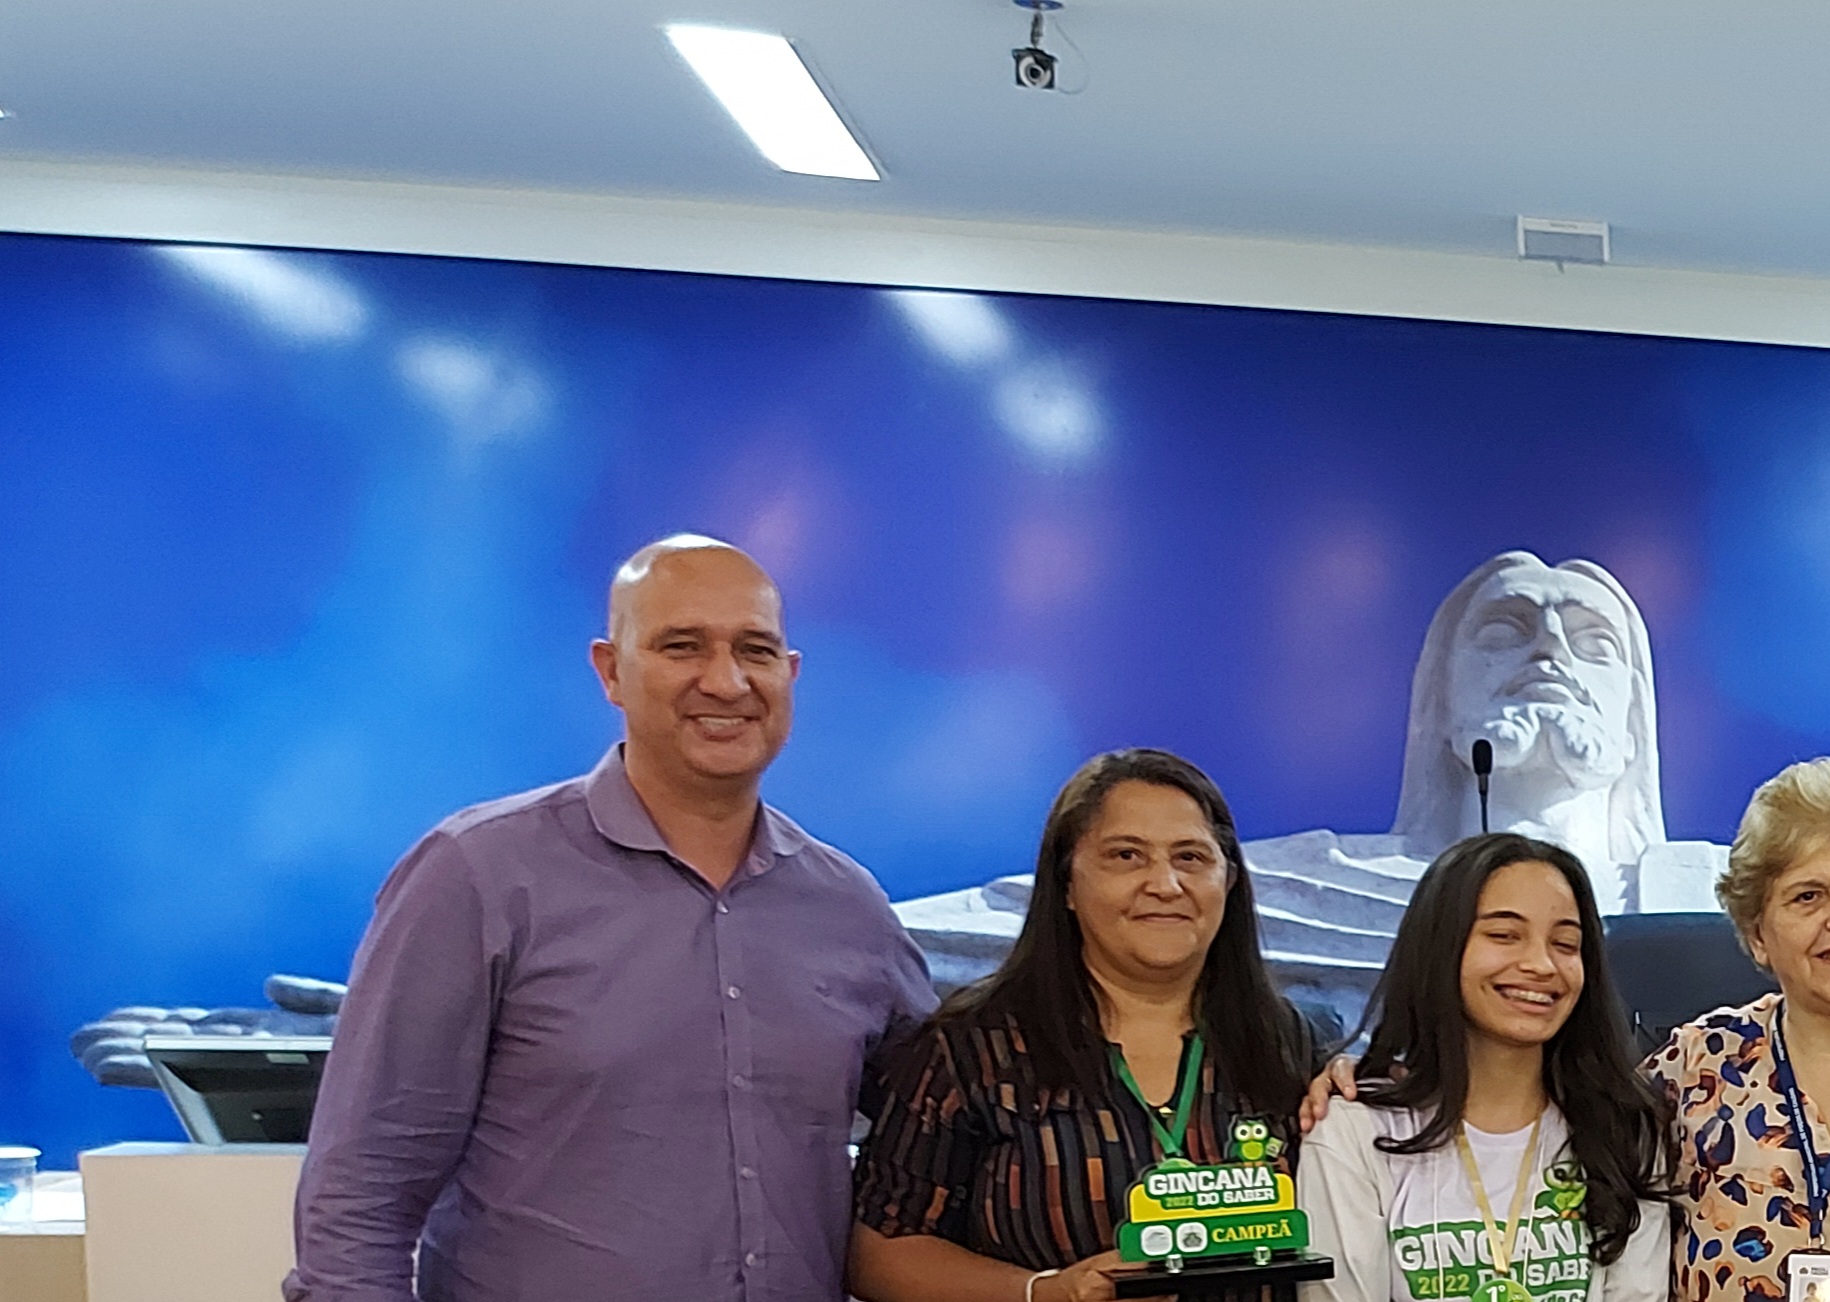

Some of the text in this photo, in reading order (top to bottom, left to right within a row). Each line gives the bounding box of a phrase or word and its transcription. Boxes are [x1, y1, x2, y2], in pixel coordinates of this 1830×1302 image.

[1148, 1167, 1274, 1195] GINCANA
[1197, 1192, 1219, 1206] DO
[1223, 1188, 1275, 1203] SABER
[1212, 1219, 1293, 1243] CAMPEÃ
[1418, 1274, 1470, 1294] 2022
[1527, 1256, 1592, 1287] SABE
